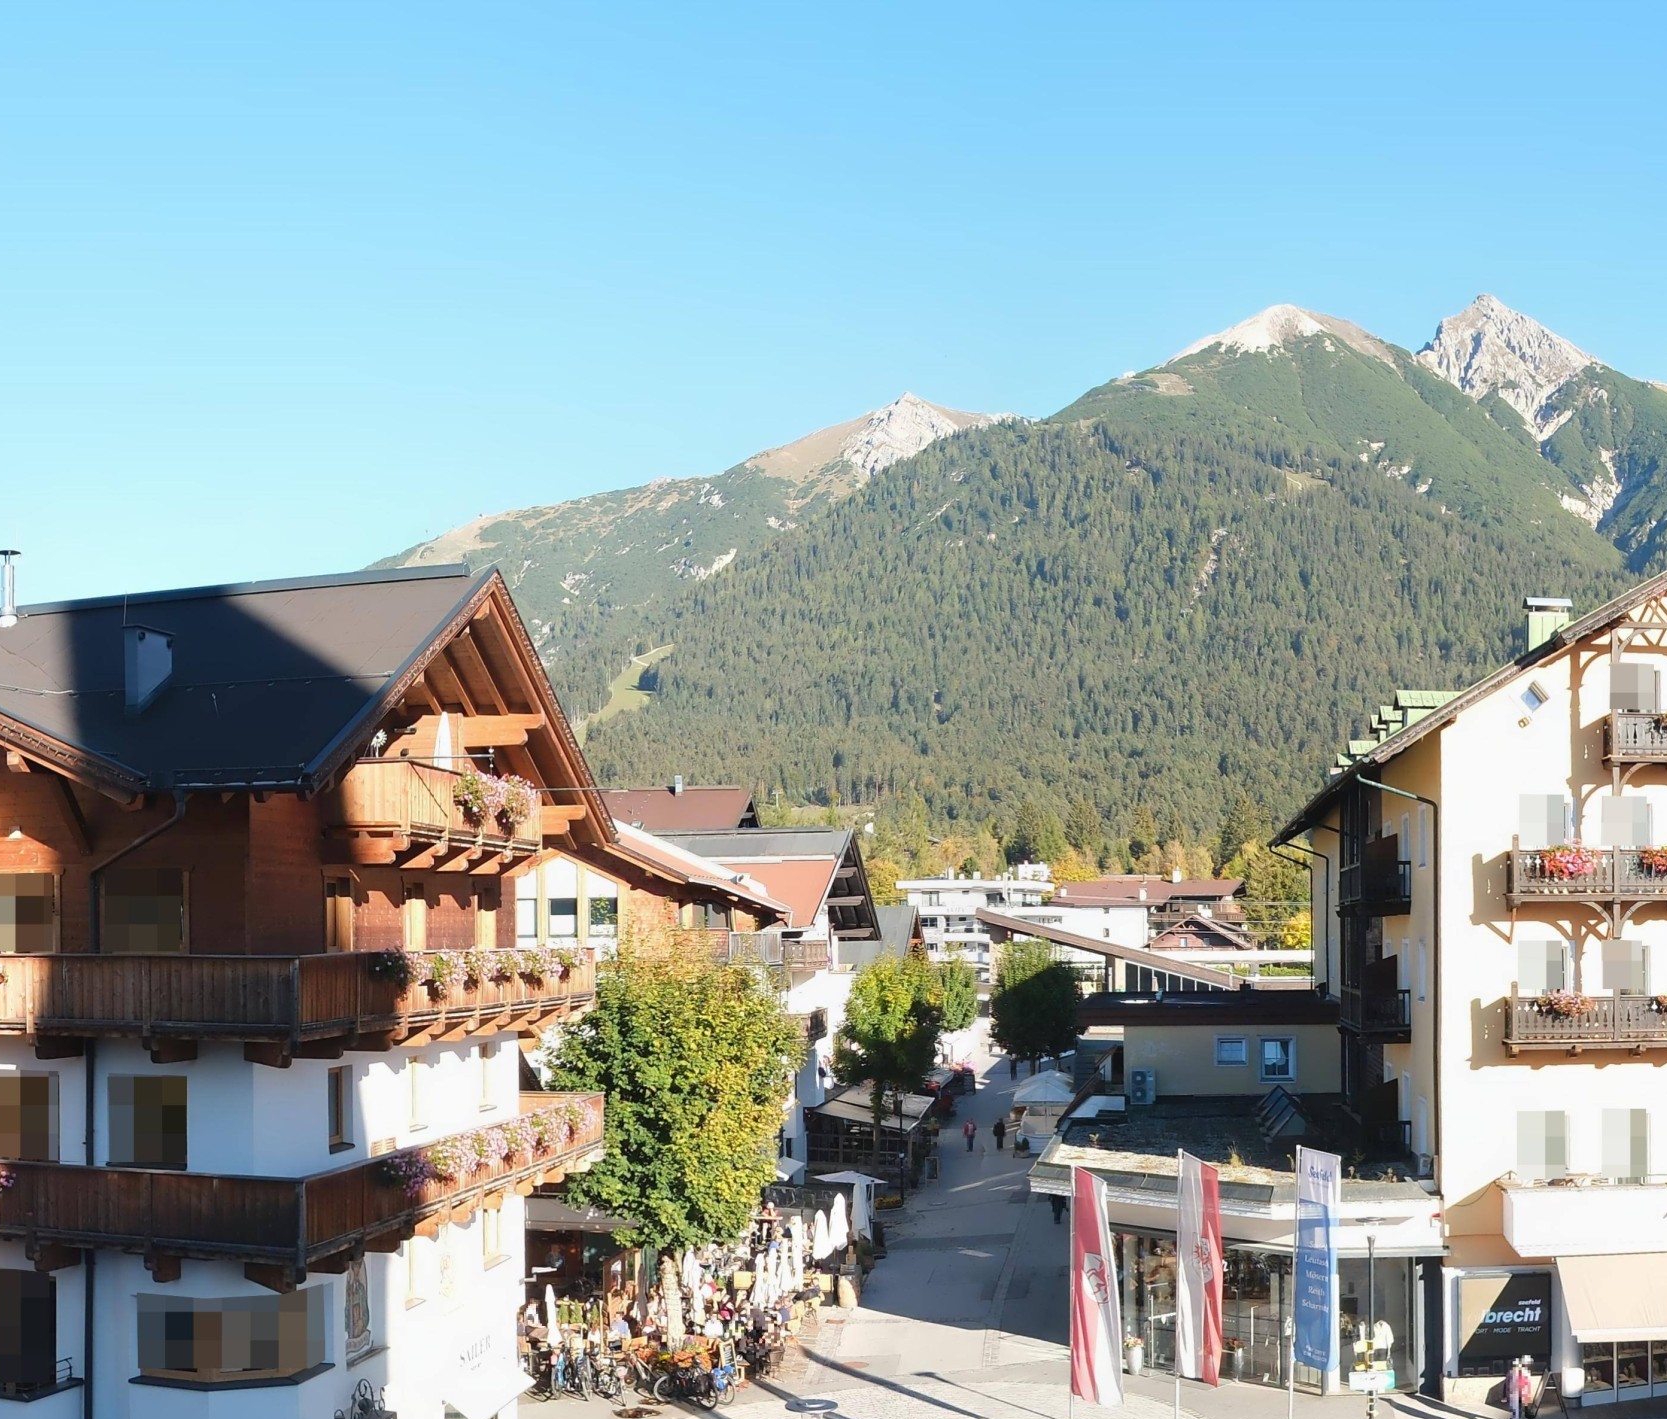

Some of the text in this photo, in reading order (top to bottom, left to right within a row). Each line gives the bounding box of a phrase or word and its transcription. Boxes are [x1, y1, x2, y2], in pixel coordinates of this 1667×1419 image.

[1308, 1285, 1326, 1297] Reith
[1518, 1298, 1542, 1306] seefeld
[1517, 1325, 1542, 1333] TRACHT
